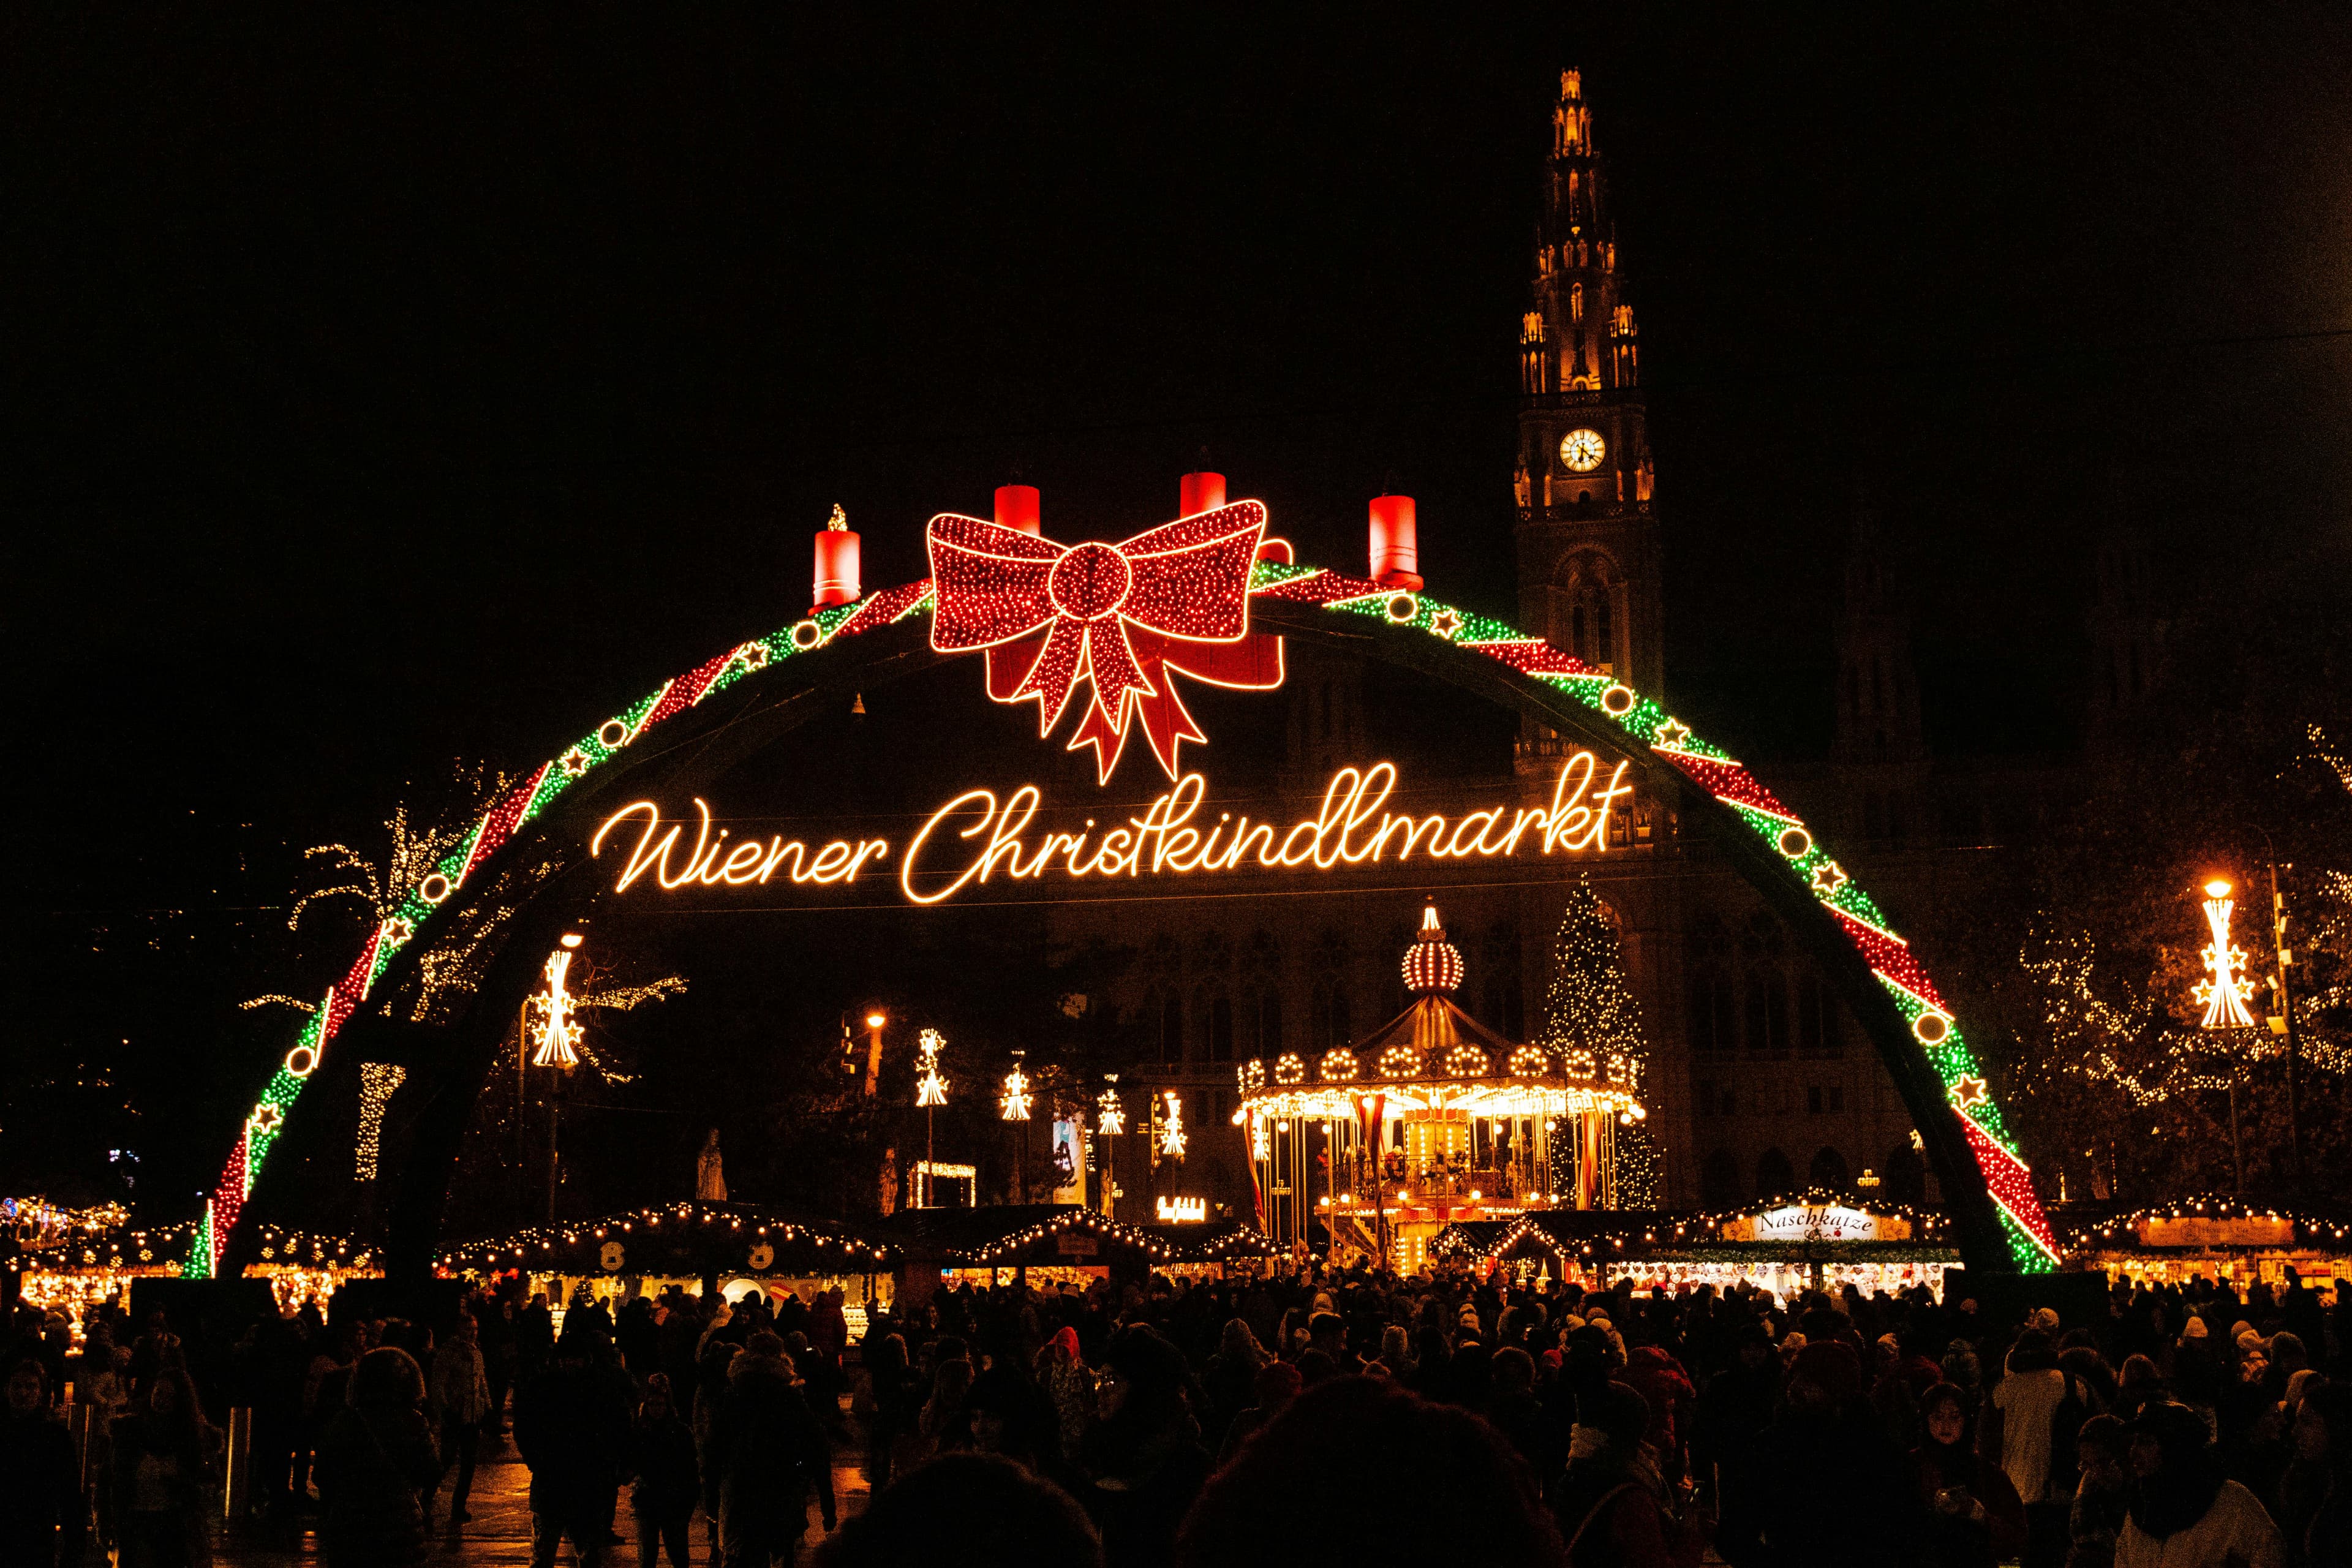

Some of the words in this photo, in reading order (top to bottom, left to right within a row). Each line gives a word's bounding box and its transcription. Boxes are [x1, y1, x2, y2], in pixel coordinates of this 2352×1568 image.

[592, 797, 888, 894] Wiener
[902, 751, 1633, 904] Christkindlmarkt
[1760, 1208, 1872, 1232] Naschkatze
